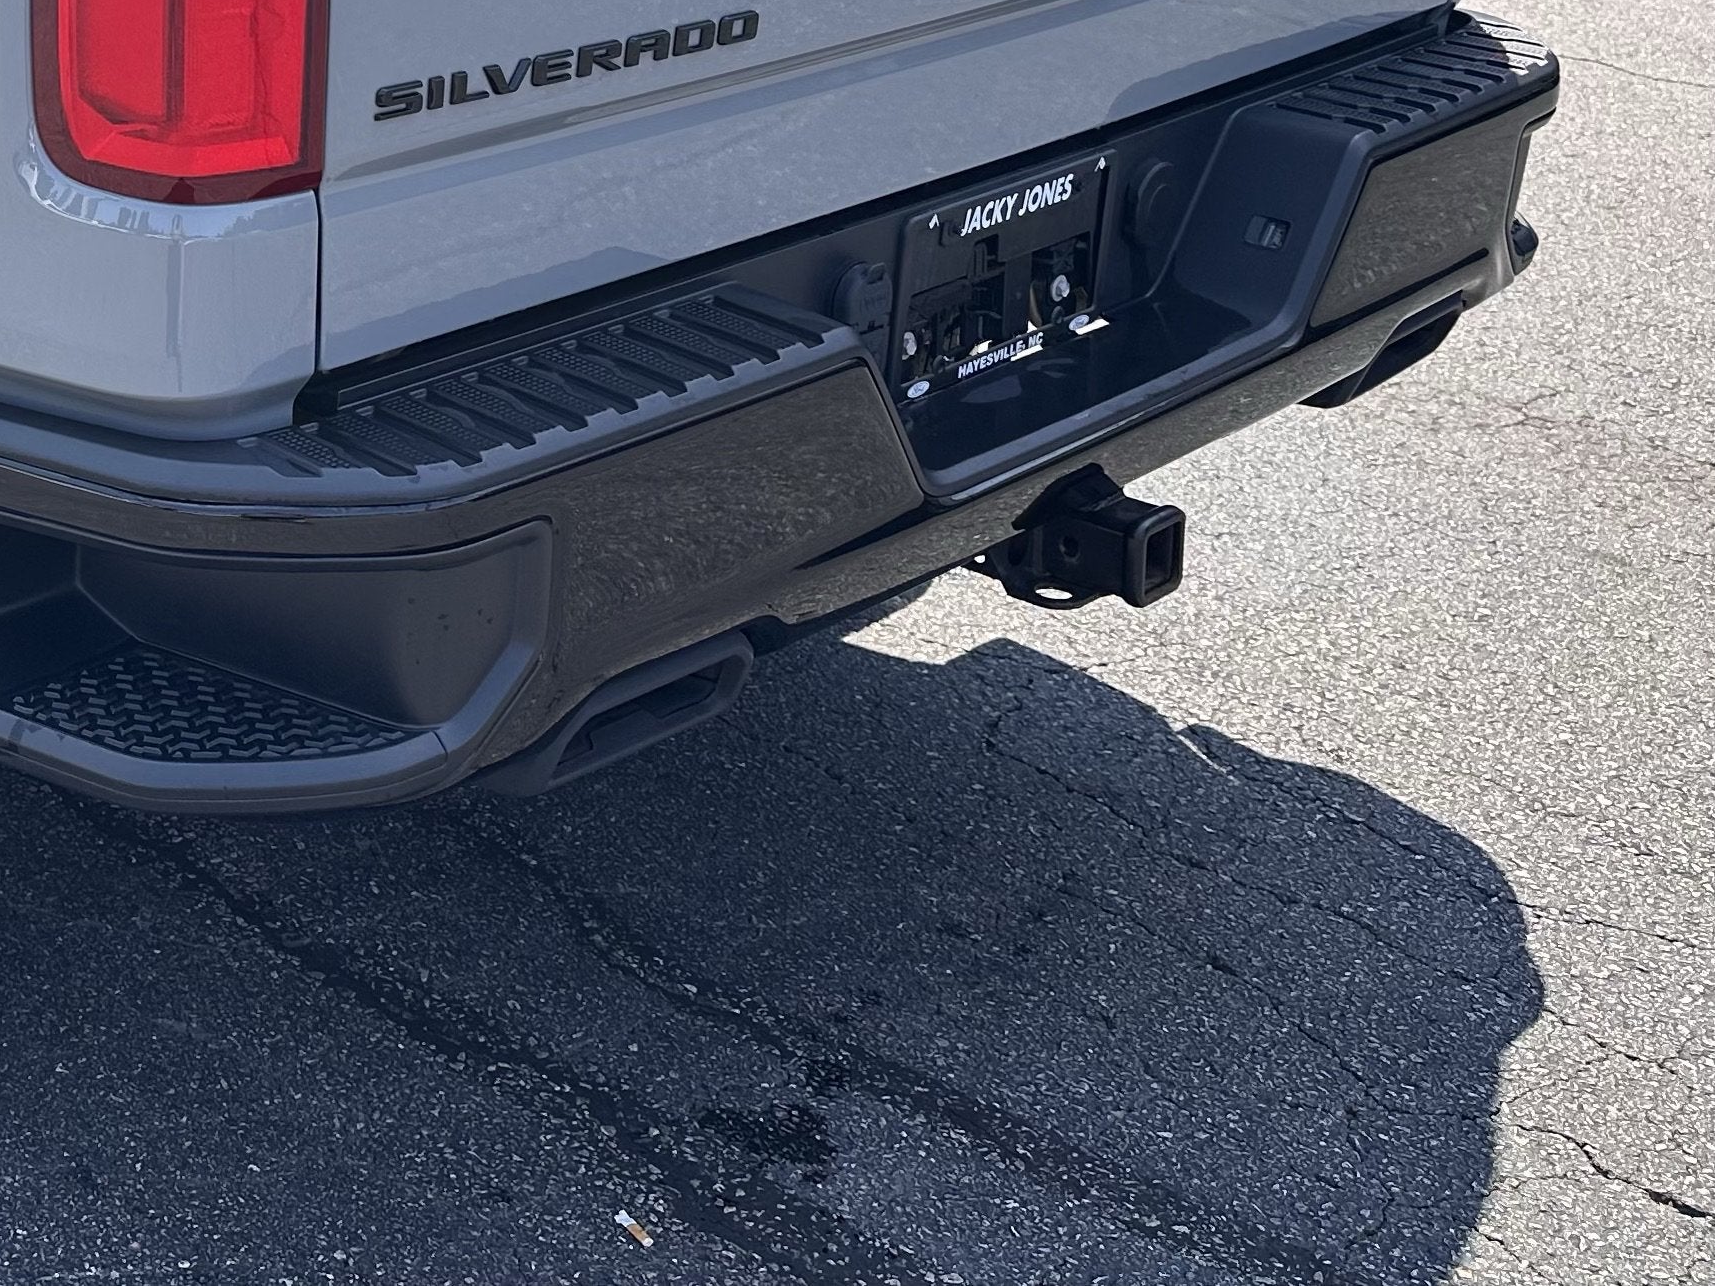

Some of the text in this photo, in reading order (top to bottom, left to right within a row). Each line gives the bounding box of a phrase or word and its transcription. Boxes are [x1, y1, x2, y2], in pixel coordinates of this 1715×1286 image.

[374, 10, 760, 122] SILVERADO
[960, 173, 1075, 237] JACKY JONES
[957, 331, 1044, 379] HAYESVILLE, NC
